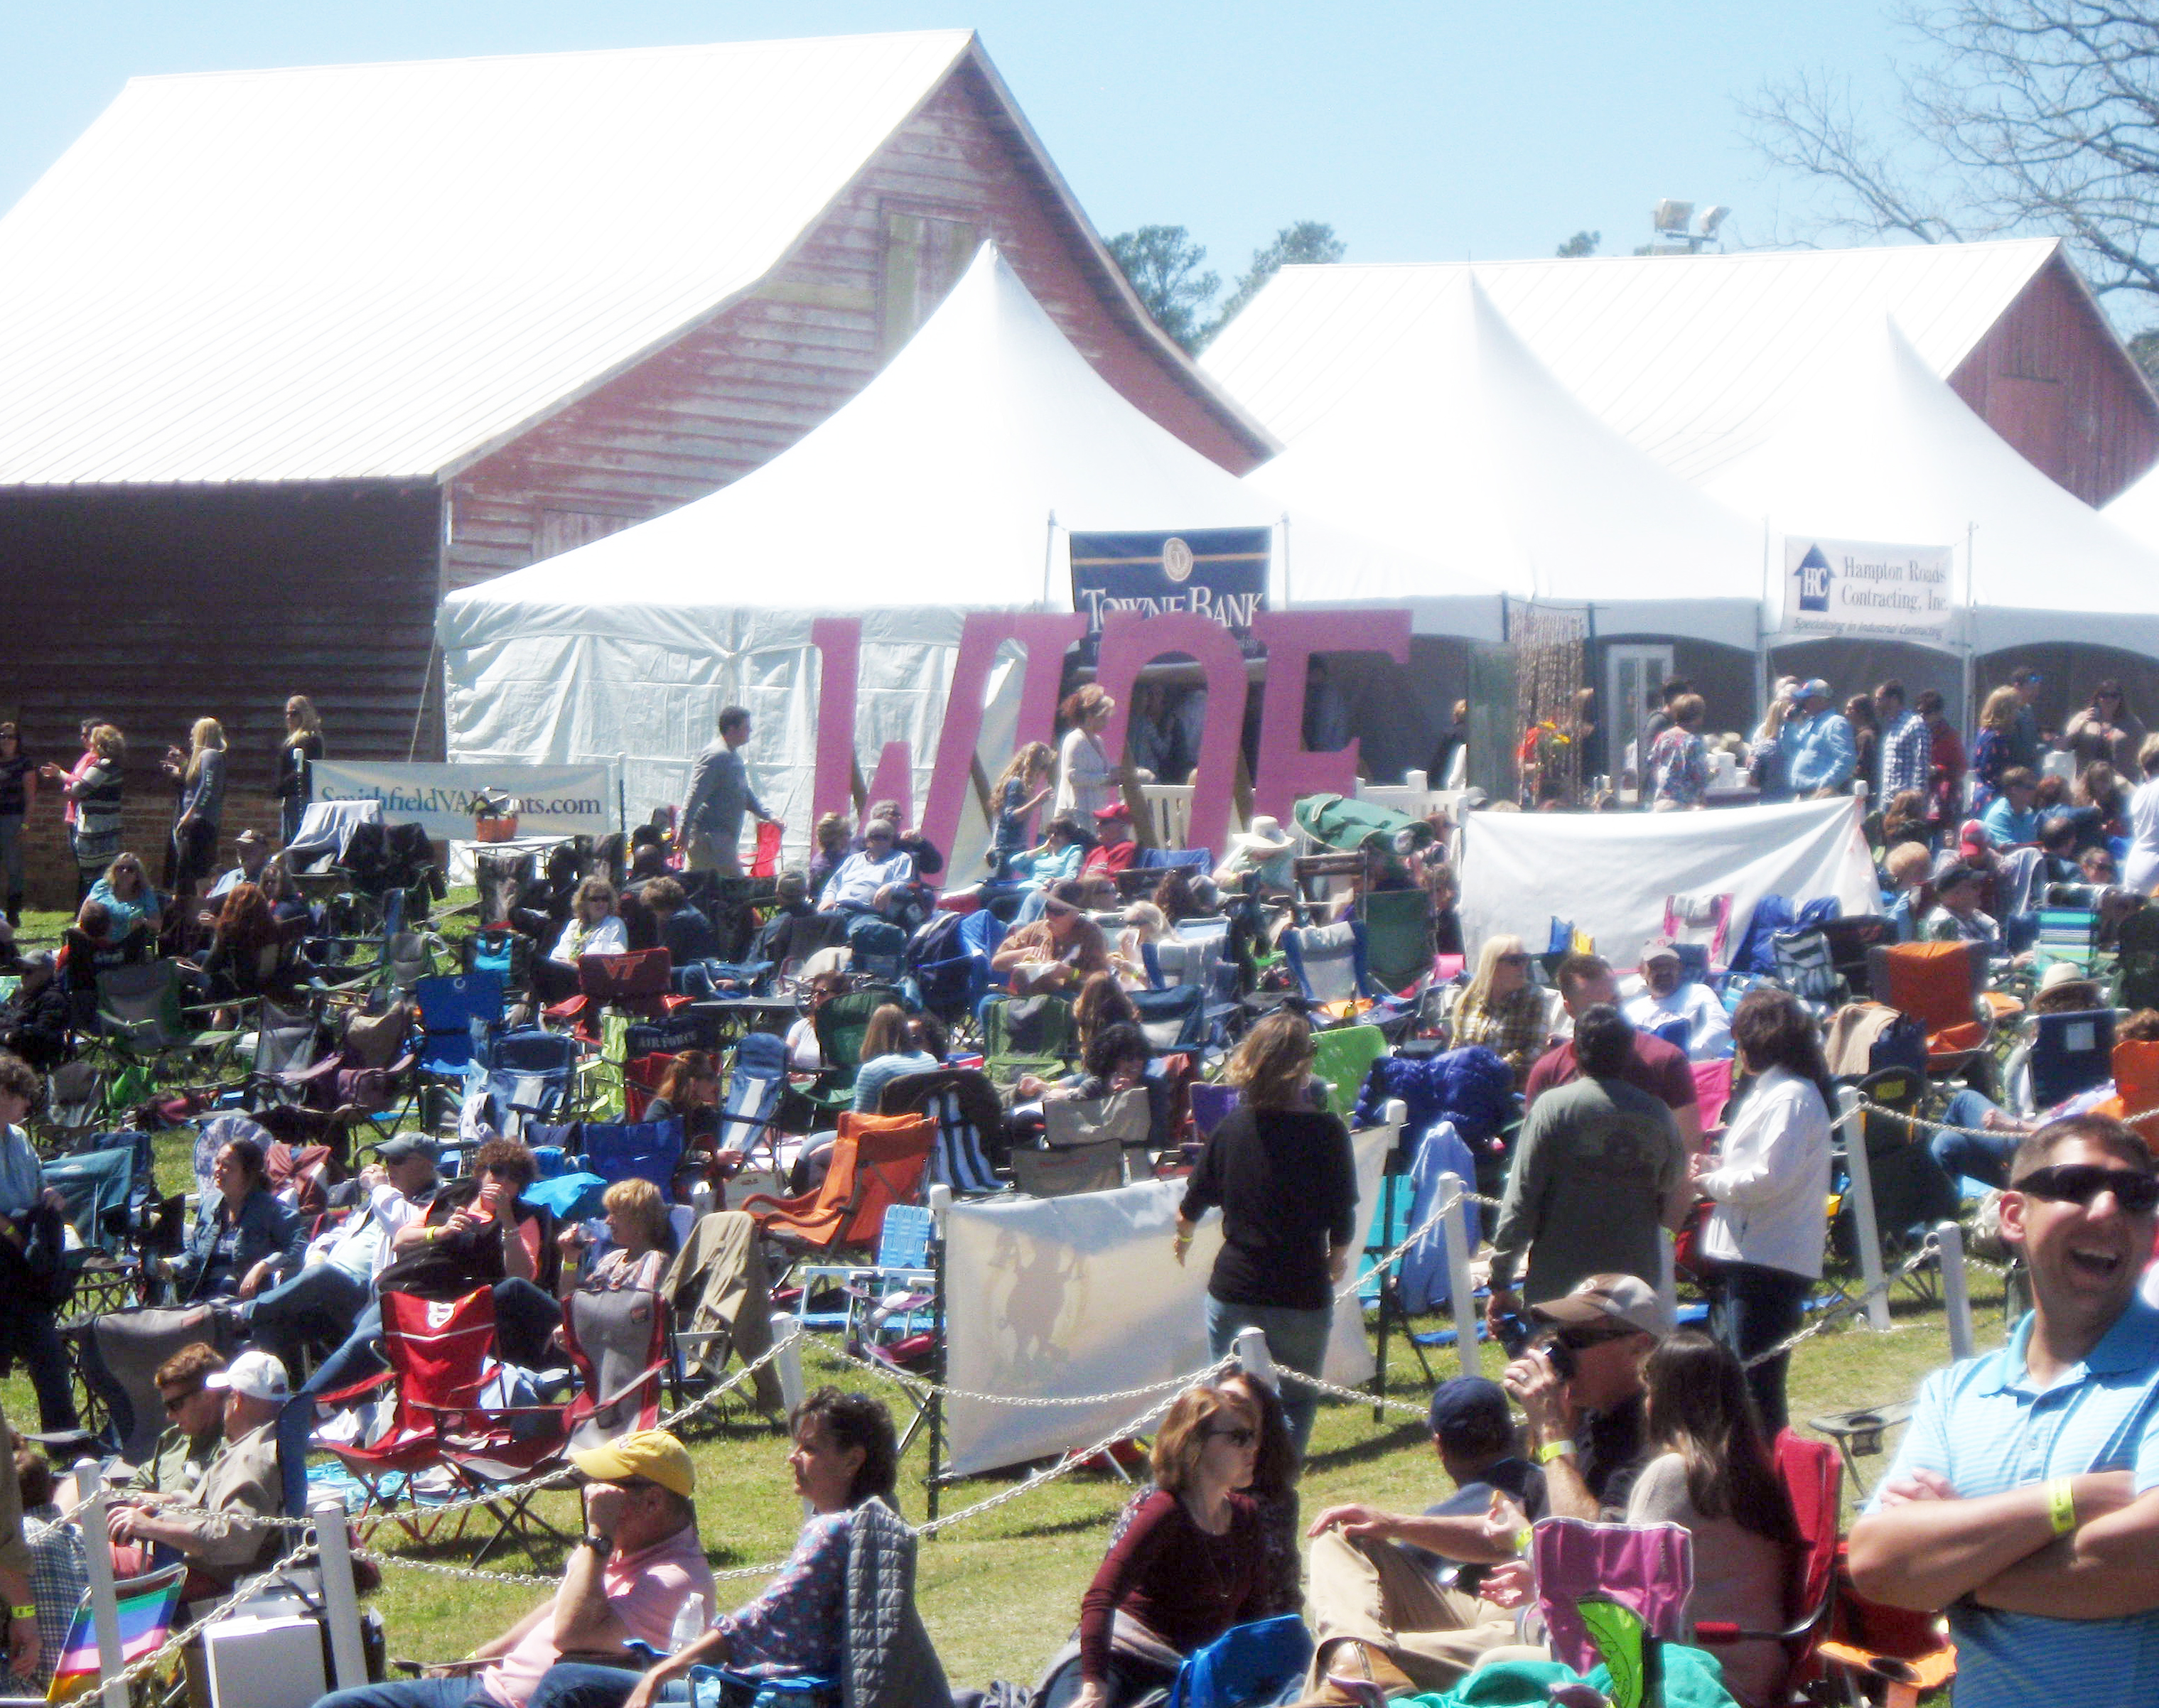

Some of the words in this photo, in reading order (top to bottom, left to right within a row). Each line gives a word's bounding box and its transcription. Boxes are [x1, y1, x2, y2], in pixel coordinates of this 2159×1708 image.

[1844, 556, 1903, 584] Hampton
[1908, 560, 1947, 583] Roads
[1842, 584, 1922, 614] Contracting,
[1927, 589, 1948, 611] Inc.
[321, 786, 602, 814] ShfieldVAnts.com
[601, 954, 647, 980] VT
